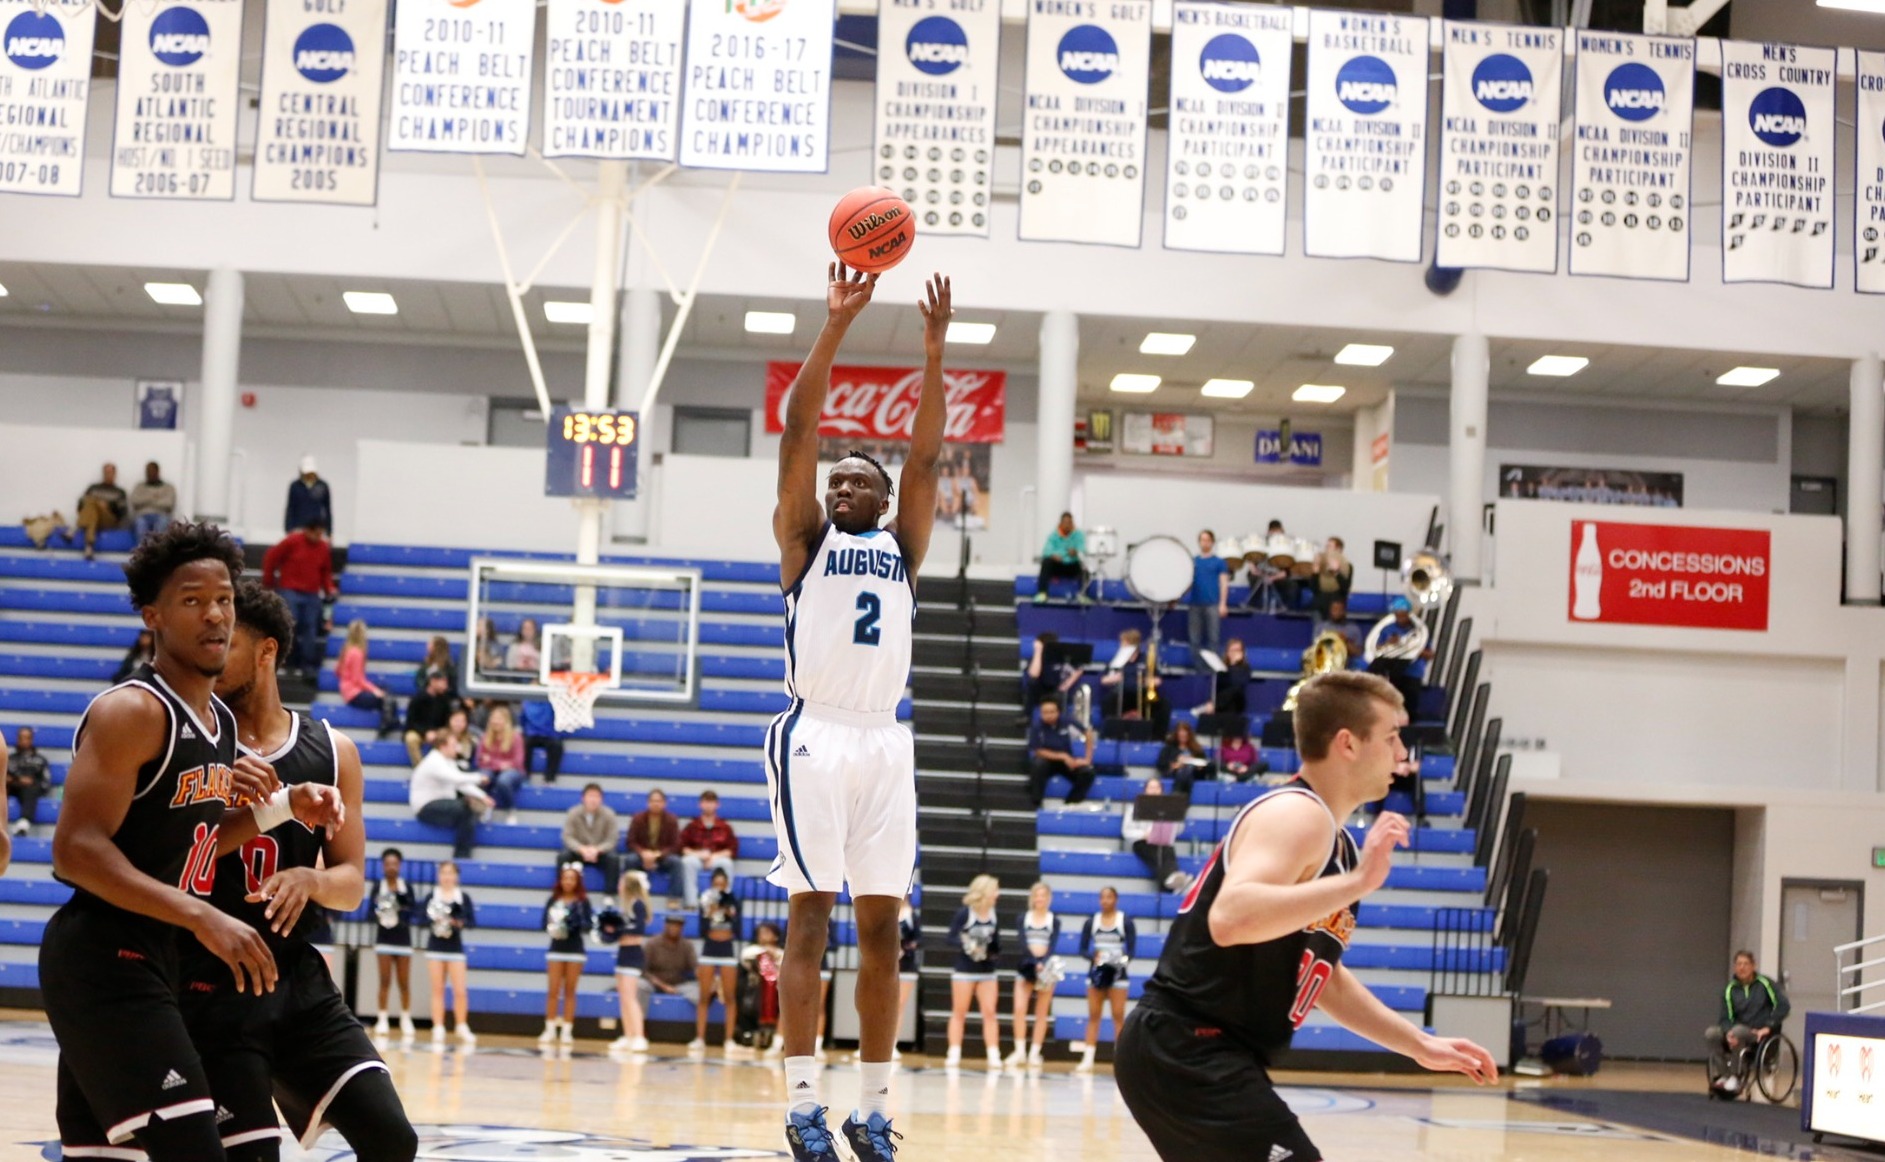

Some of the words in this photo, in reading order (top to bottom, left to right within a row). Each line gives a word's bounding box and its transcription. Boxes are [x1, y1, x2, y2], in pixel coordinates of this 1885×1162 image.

[576, 10, 655, 36] 2010-11
[1111, 4, 1145, 20] GOLF
[1216, 11, 1287, 30] BASKETBALL
[424, 18, 505, 44] 2010-11
[1507, 31, 1556, 50] TENNIS
[6, 37, 64, 57] NCAA
[152, 34, 209, 54] NCAA
[551, 39, 611, 63] PEACH
[629, 41, 677, 67] BELT
[712, 33, 806, 61] 2016-17
[909, 42, 968, 63] NCAA
[1325, 34, 1413, 55] BASKETBALL
[1649, 41, 1692, 60] TENNIS
[296, 50, 354, 70] NCAA
[398, 50, 459, 76] PEACH
[479, 53, 526, 78] BELT
[1061, 51, 1118, 72] NCAA
[1203, 59, 1260, 81] NCAA
[151, 73, 205, 93] SOUTH
[552, 68, 673, 96] CONFERENCE
[693, 65, 754, 92] PEACH
[774, 69, 820, 94] BELT
[1727, 62, 1767, 81] CROSS
[1779, 66, 1831, 86] COUNTRY
[1861, 74, 1885, 92] CRO
[28, 77, 87, 100] ATLANTIC
[400, 82, 520, 111] CONFERENCE
[898, 81, 957, 99] DIVISION
[1340, 81, 1397, 103] NCAA
[1477, 80, 1533, 100] NCAA
[1609, 89, 1664, 109] NCAA
[136, 97, 216, 119] ATLANTIC
[279, 92, 360, 118] CENTRAL
[553, 97, 670, 124] TOURNAMENT
[696, 98, 816, 126] CONFERENCE
[886, 101, 986, 122] CHAMPIONSHIP
[1029, 95, 1060, 110] NCAA
[1075, 97, 1125, 114] DIVISION
[1177, 98, 1205, 114] NCAA
[1217, 100, 1264, 116] DIVISION
[134, 122, 215, 145] REGIONAL
[275, 118, 362, 143] REGIONAL
[399, 116, 518, 144] CHAMPIONS
[885, 123, 986, 143] APPEARANCES
[1034, 115, 1135, 136] CHAMPIONSHIP
[1180, 118, 1279, 138] CHAMPIONSHIP
[1313, 118, 1342, 132] NCAA
[1354, 119, 1400, 136] DIVISION
[1447, 118, 1477, 133] NCAA
[1488, 120, 1537, 137] DIVISION
[1578, 125, 1609, 142] NCAA
[1619, 128, 1668, 146] DIVISION
[1753, 114, 1805, 135] NCAA
[553, 126, 667, 153] CHAMPIONS
[694, 129, 815, 157] CHAMPIONS
[1034, 137, 1135, 159] APPEARANCES
[1184, 139, 1273, 159] PARTICIPANT
[1317, 137, 1415, 156] CHAMPIONSHIP
[1451, 138, 1551, 160] CHAMPIONSHIP
[266, 143, 368, 168] CHAMPIONS
[1322, 156, 1408, 175] PARTICIPANT
[1583, 146, 1683, 168] CHAMPIONSHIP
[1739, 151, 1796, 170] DIVISION
[291, 169, 337, 191] 2005
[1457, 159, 1542, 180] PARTICIPANT
[1589, 167, 1675, 189] PARTICIPANT
[135, 172, 210, 194] 2006-07
[1732, 171, 1826, 193] CHAMPIONSHIP
[1736, 192, 1821, 213] PARTICIPANT
[847, 206, 902, 240] Wilson
[868, 231, 907, 259] NCAA
[563, 413, 635, 446] 13:53
[1258, 437, 1319, 458] DAANI
[1608, 549, 1765, 577] CONCESSIONS
[1629, 579, 1666, 599] 2nd
[1671, 580, 1743, 603] FLOOR
[852, 591, 881, 647] 2
